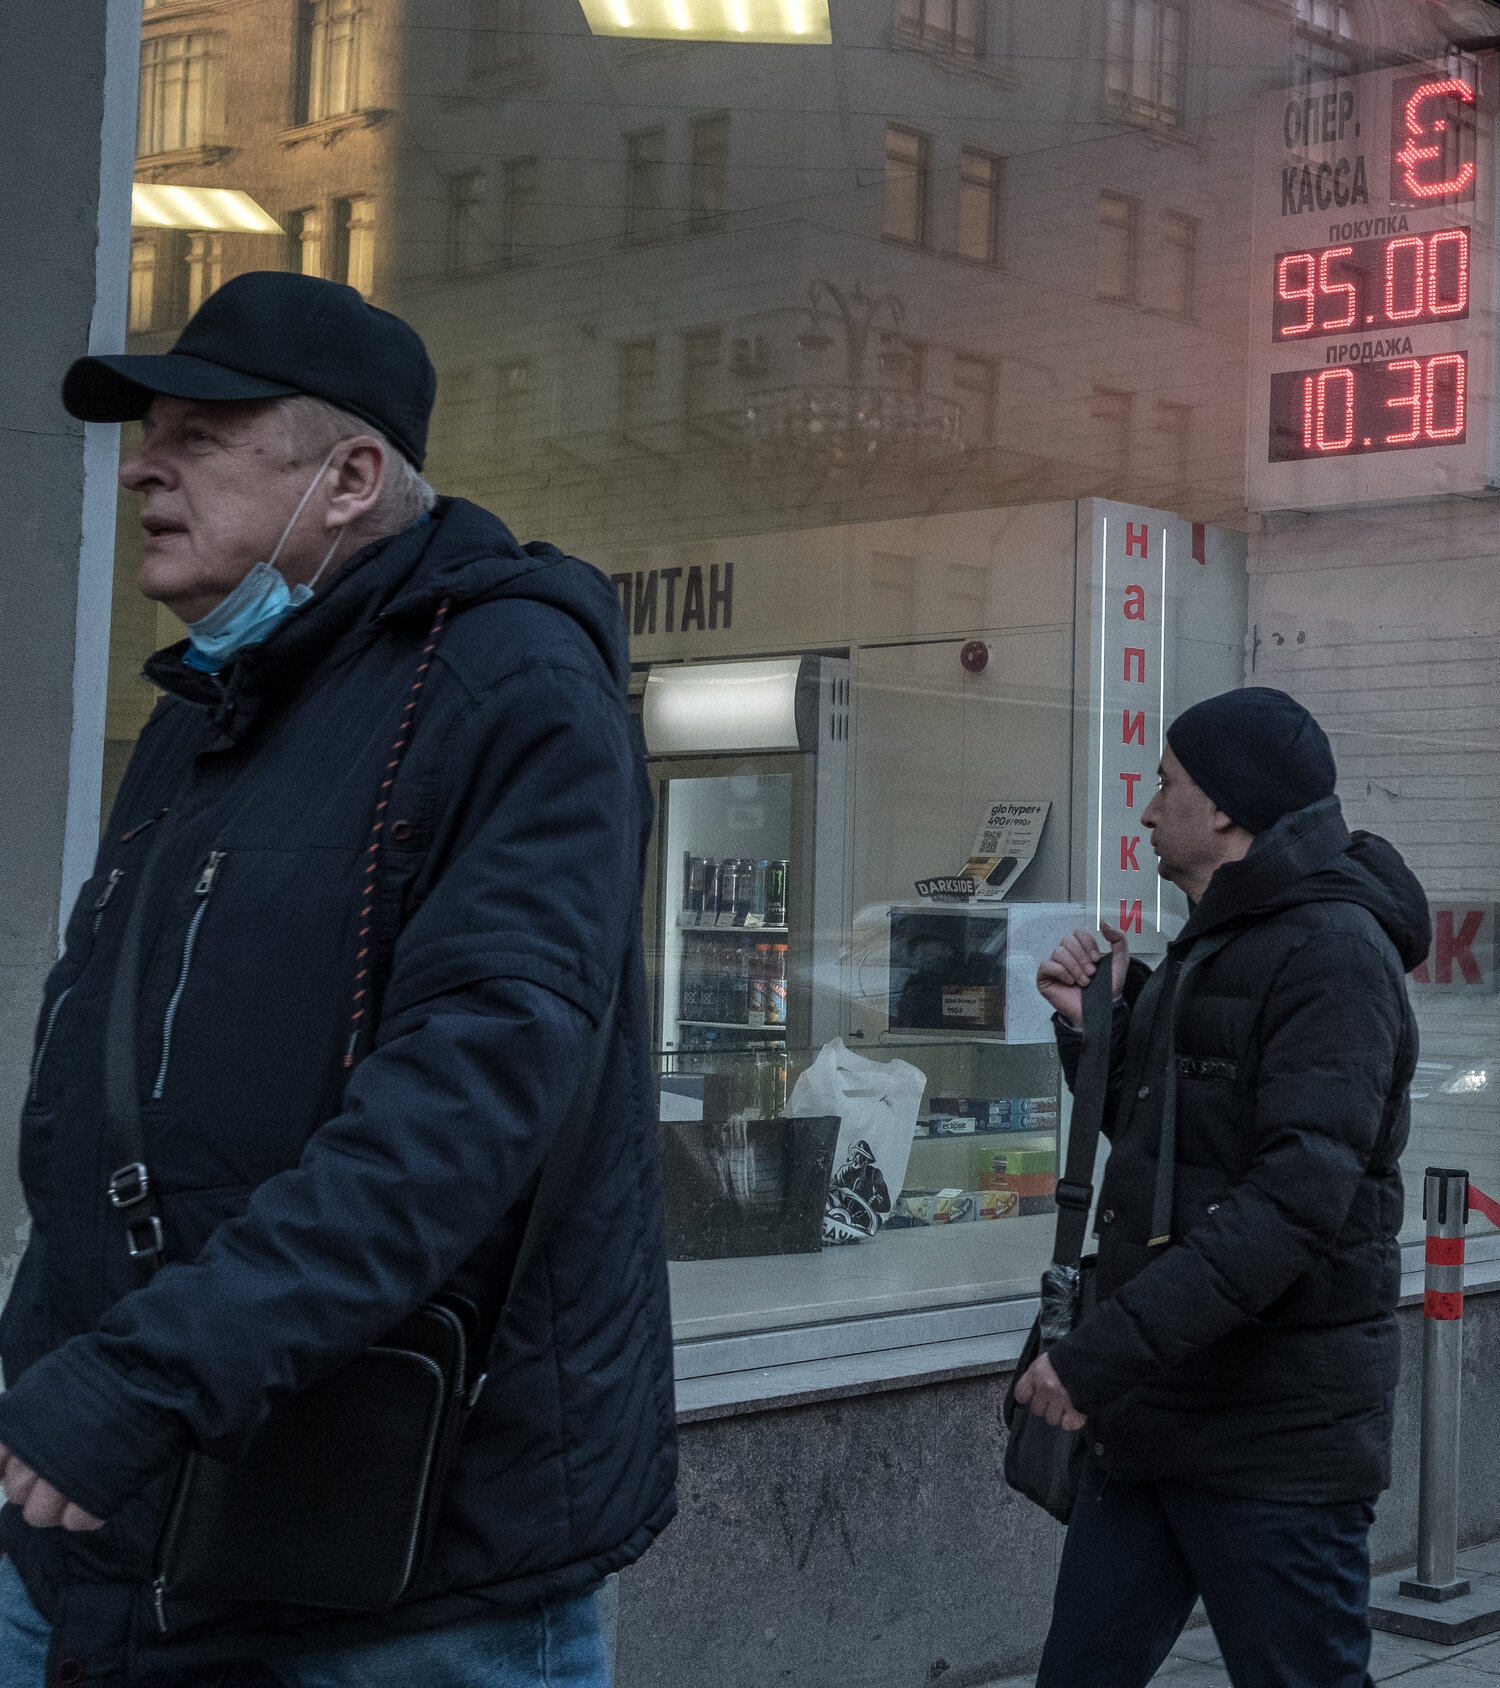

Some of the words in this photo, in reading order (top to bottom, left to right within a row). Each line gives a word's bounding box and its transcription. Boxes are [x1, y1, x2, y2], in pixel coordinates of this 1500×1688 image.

[1283, 90, 1361, 149] ОПЕР.
[1281, 154, 1369, 217] КАССА
[1328, 214, 1409, 242] ПОКУПКА
[1278, 230, 1469, 336] 95.00
[1326, 336, 1413, 364] ПРОДАЖА
[1304, 354, 1465, 451] 10.30
[991, 804, 1007, 816] glo
[1008, 804, 1042, 816] hyper+
[918, 880, 974, 896] DARKSIDE
[1412, 910, 1486, 985] К
[942, 1121, 967, 1130] eclipse
